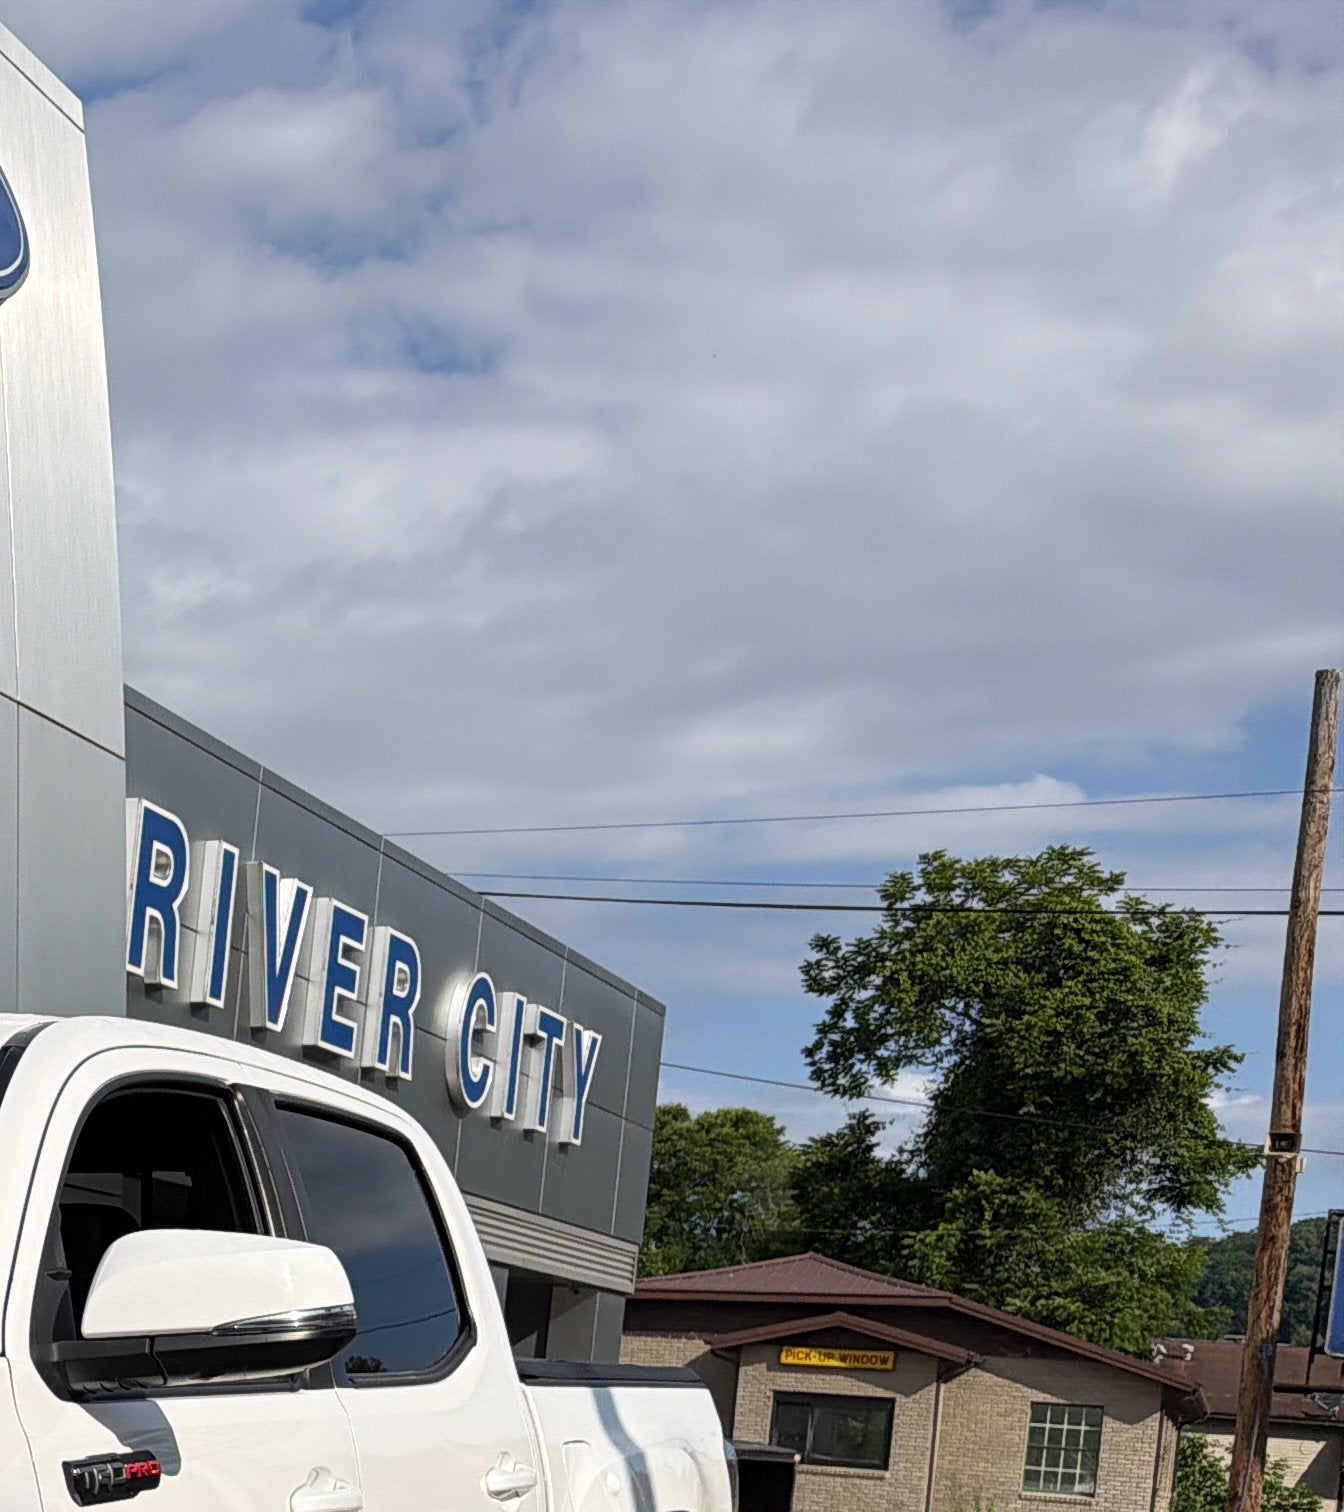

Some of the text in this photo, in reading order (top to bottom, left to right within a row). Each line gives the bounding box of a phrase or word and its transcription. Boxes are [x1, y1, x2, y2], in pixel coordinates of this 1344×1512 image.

[126, 797, 602, 1146] RIVER CITY
[839, 1352, 890, 1365] WINDOW
[124, 1461, 161, 1479] PRO
